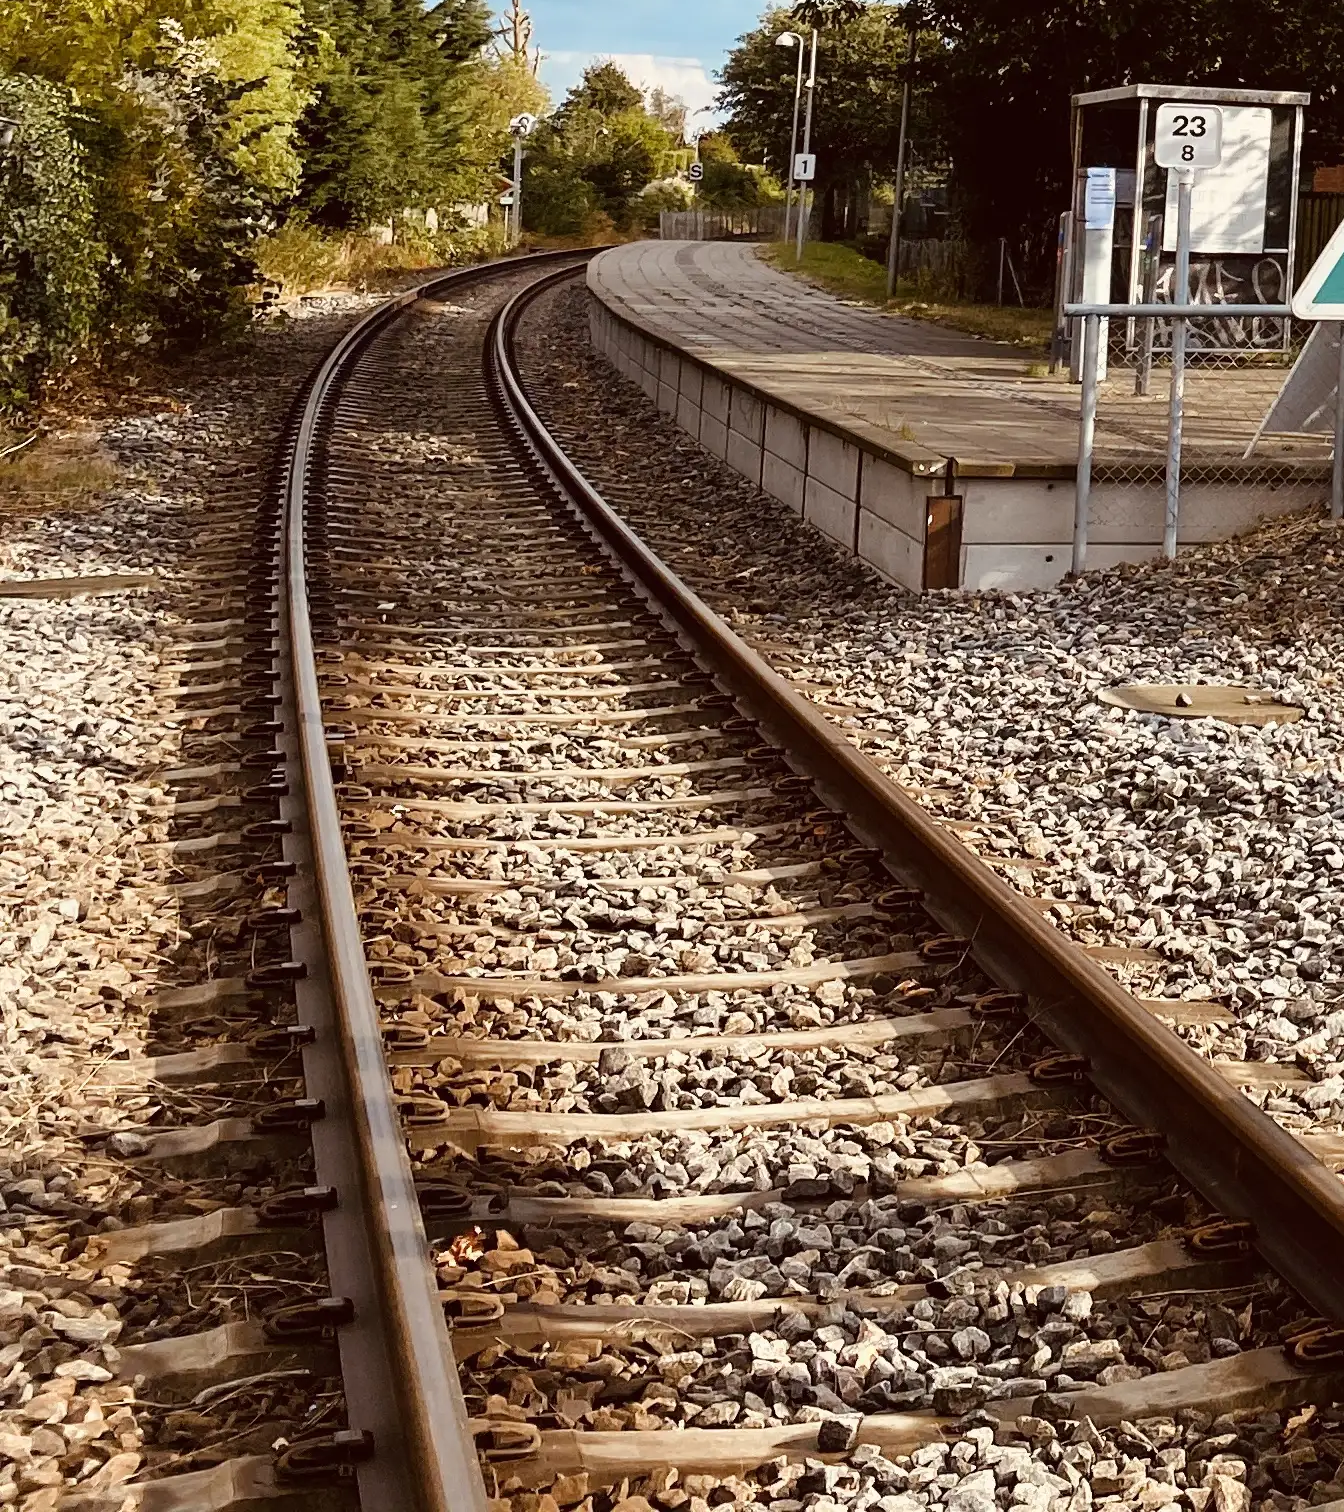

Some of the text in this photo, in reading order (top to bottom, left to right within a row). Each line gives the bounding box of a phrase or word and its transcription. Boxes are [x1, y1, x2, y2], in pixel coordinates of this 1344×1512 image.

[1172, 115, 1206, 137] 23
[1181, 145, 1194, 161] 8
[691, 165, 701, 178] S
[801, 159, 808, 174] 1
